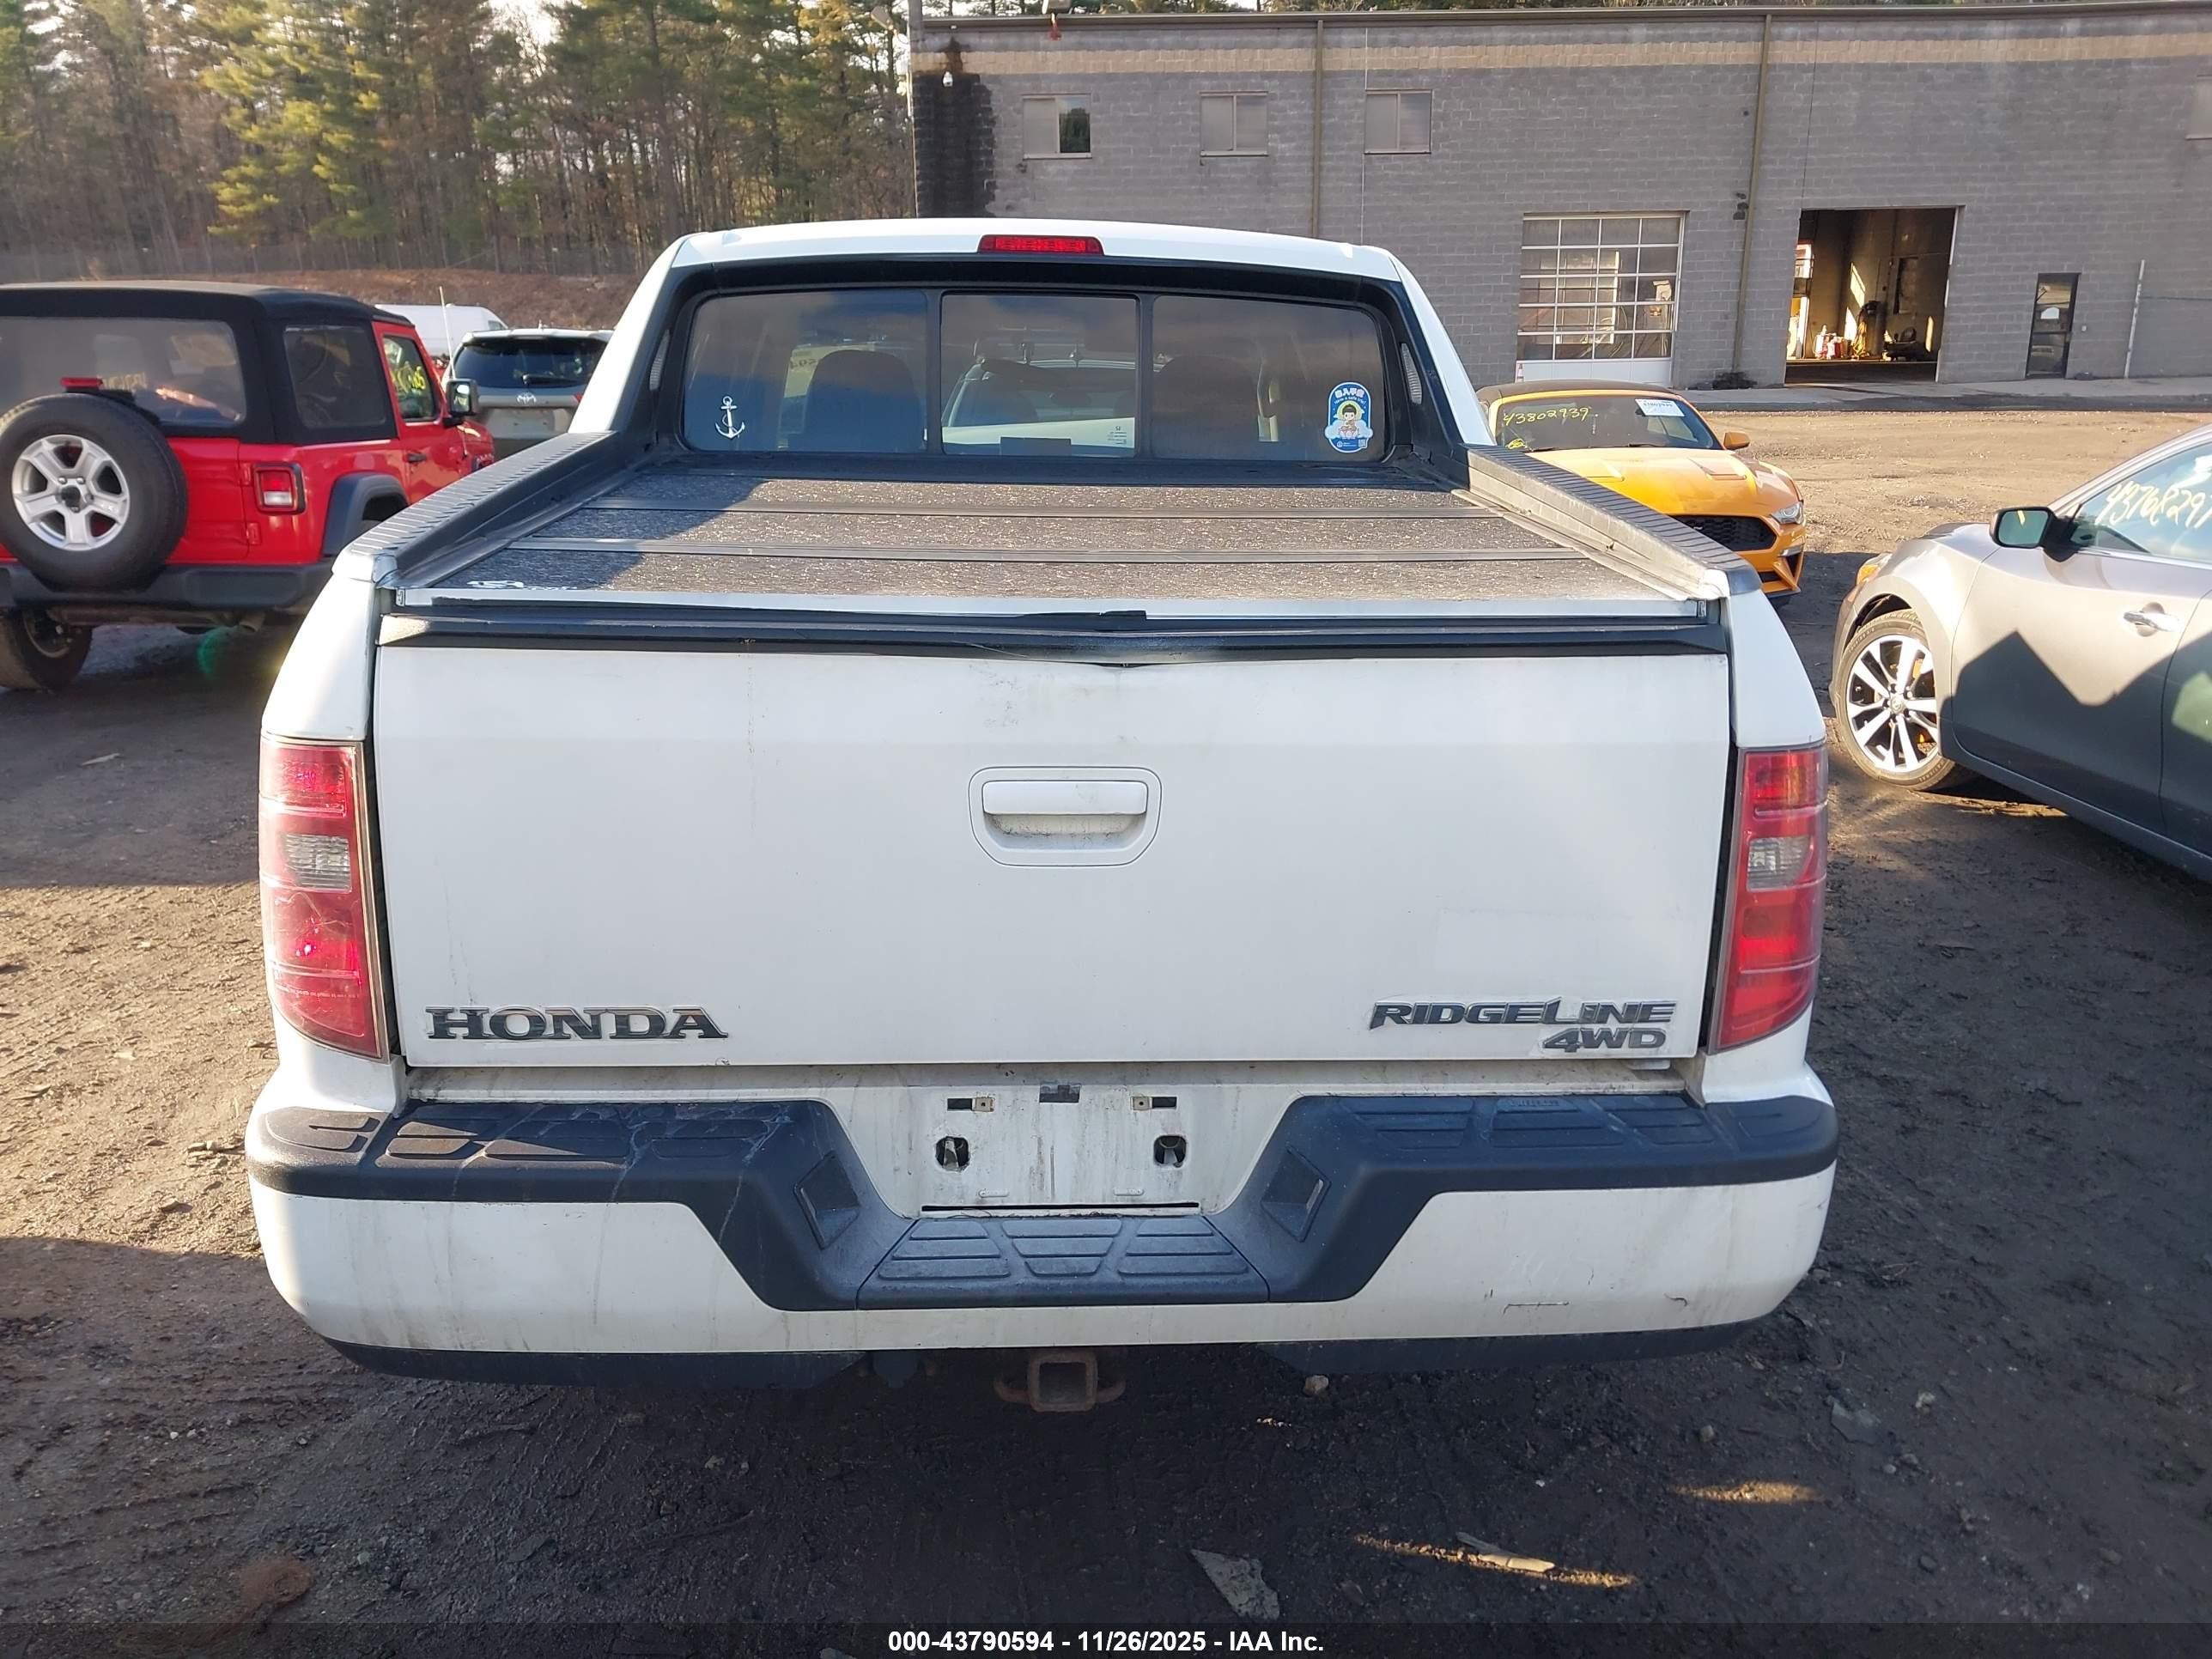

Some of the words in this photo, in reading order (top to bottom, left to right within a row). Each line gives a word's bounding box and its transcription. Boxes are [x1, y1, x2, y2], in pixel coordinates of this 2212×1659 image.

[1503, 407, 1589, 426] 43802939
[425, 1006, 729, 1041] HONDA
[1369, 996, 1676, 1030] RIDGELINE
[1541, 1027, 1668, 1053] 4WD
